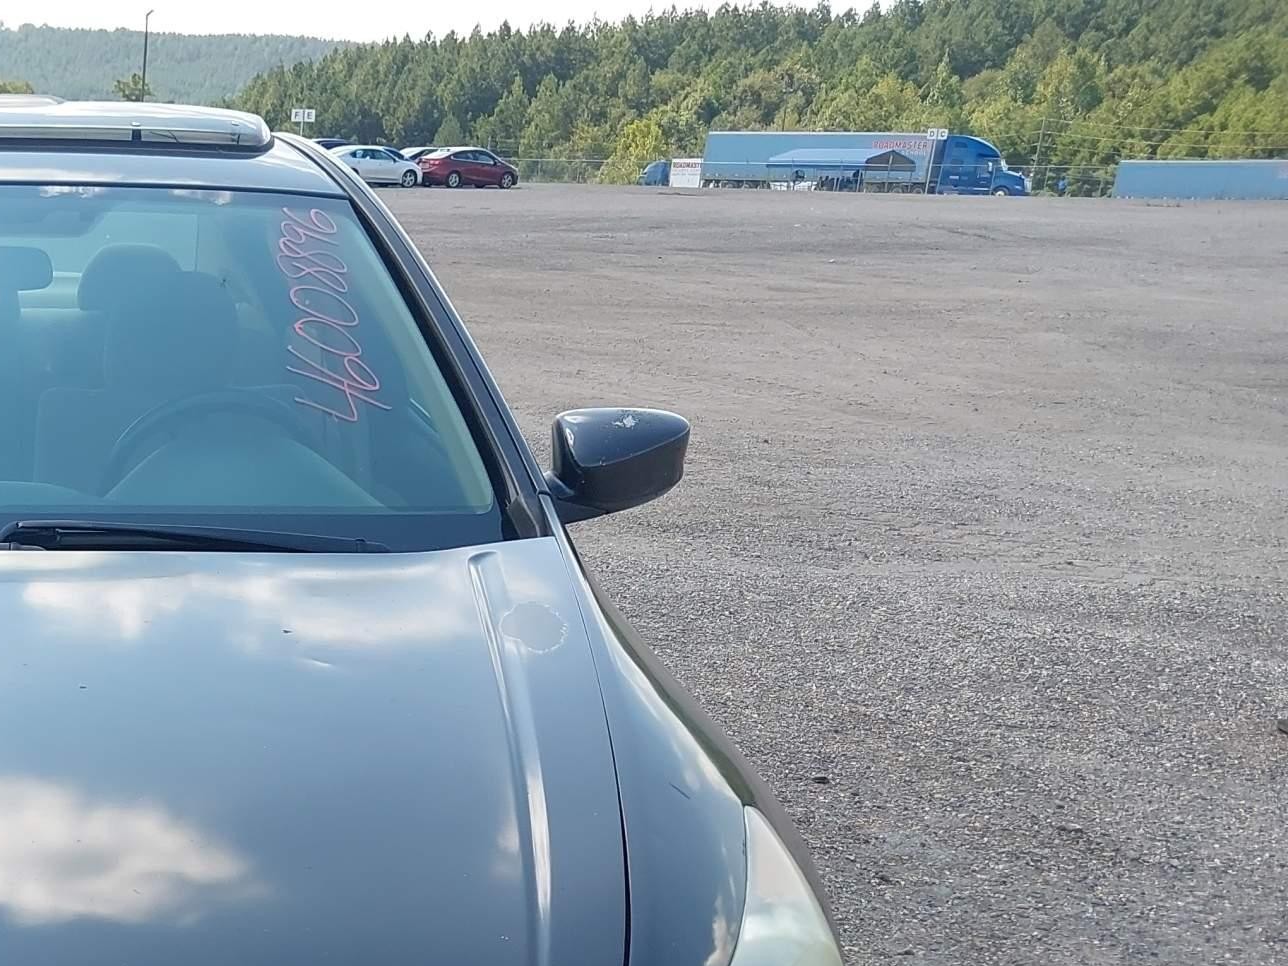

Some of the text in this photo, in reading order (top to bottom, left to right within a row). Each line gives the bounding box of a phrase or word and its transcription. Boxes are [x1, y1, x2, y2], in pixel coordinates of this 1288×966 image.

[295, 111, 313, 120] F E
[873, 141, 928, 150] ROADMASTER
[277, 207, 392, 422] 46008896
